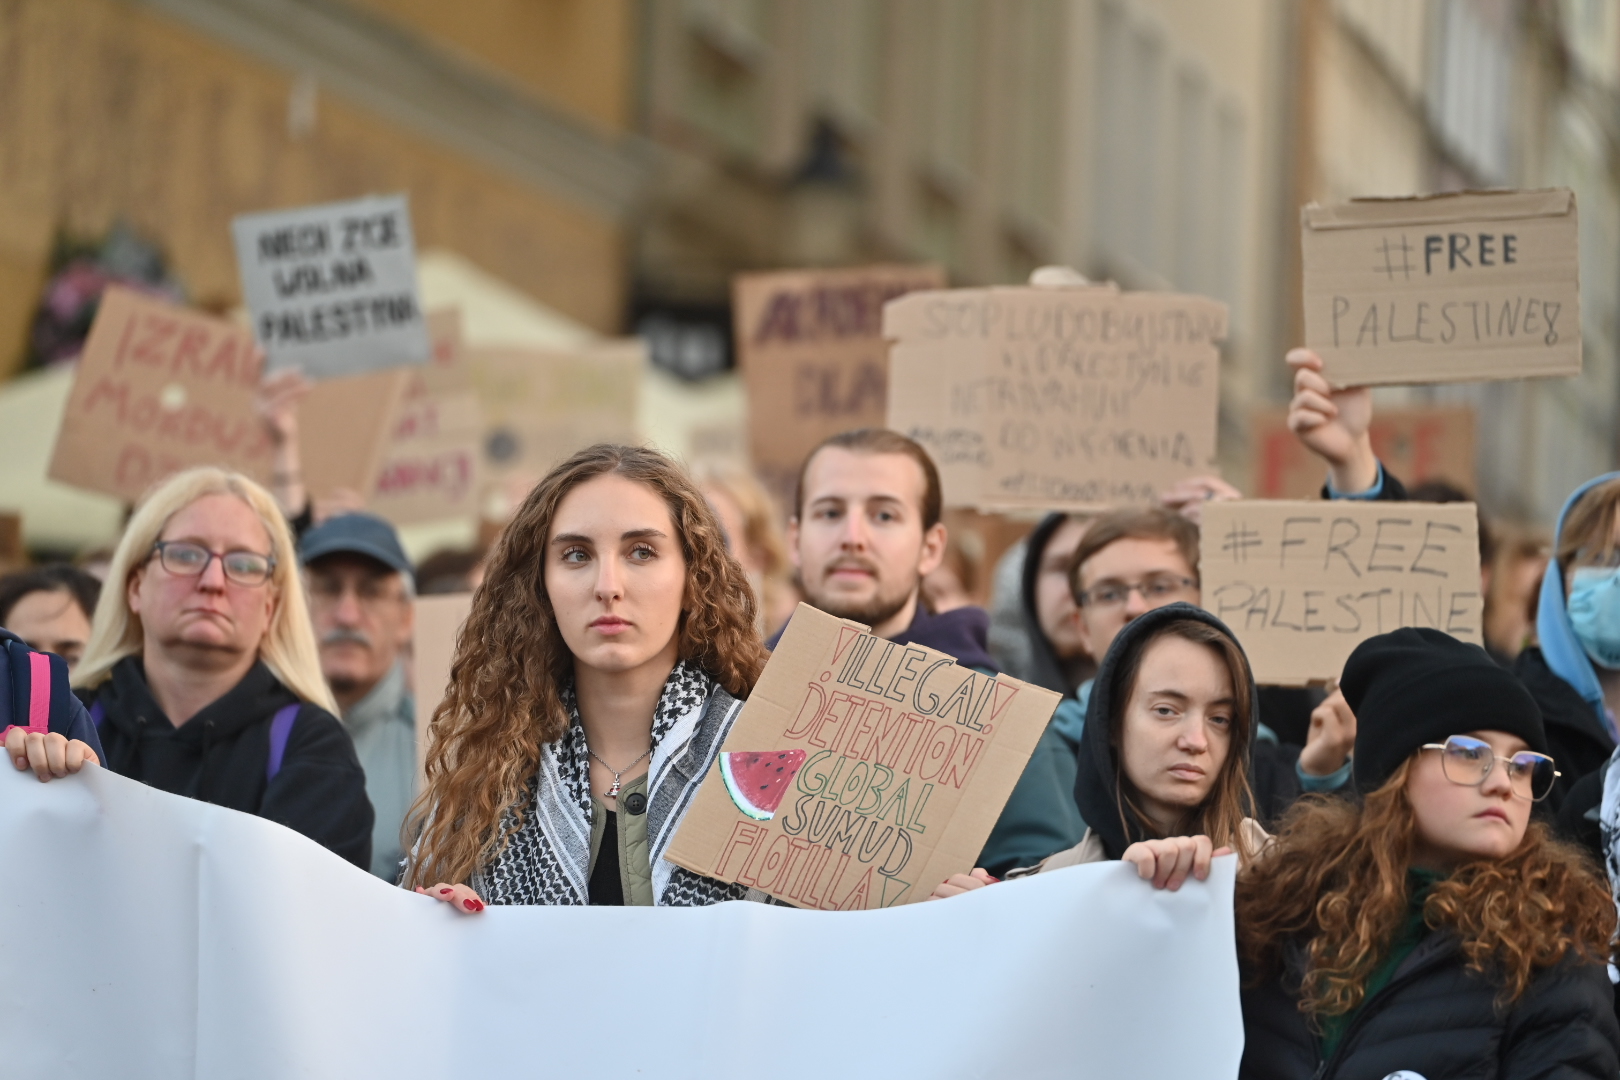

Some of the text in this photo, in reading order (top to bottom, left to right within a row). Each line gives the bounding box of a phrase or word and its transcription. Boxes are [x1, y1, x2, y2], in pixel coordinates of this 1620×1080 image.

[274, 257, 373, 297] WOLNA
[1332, 295, 1561, 348] PALESTINE!
[1213, 580, 1478, 634] PALESTINE
[783, 682, 985, 789] DETENTION
[797, 750, 934, 834] GLOBAL
[782, 794, 912, 876] SUMUD
